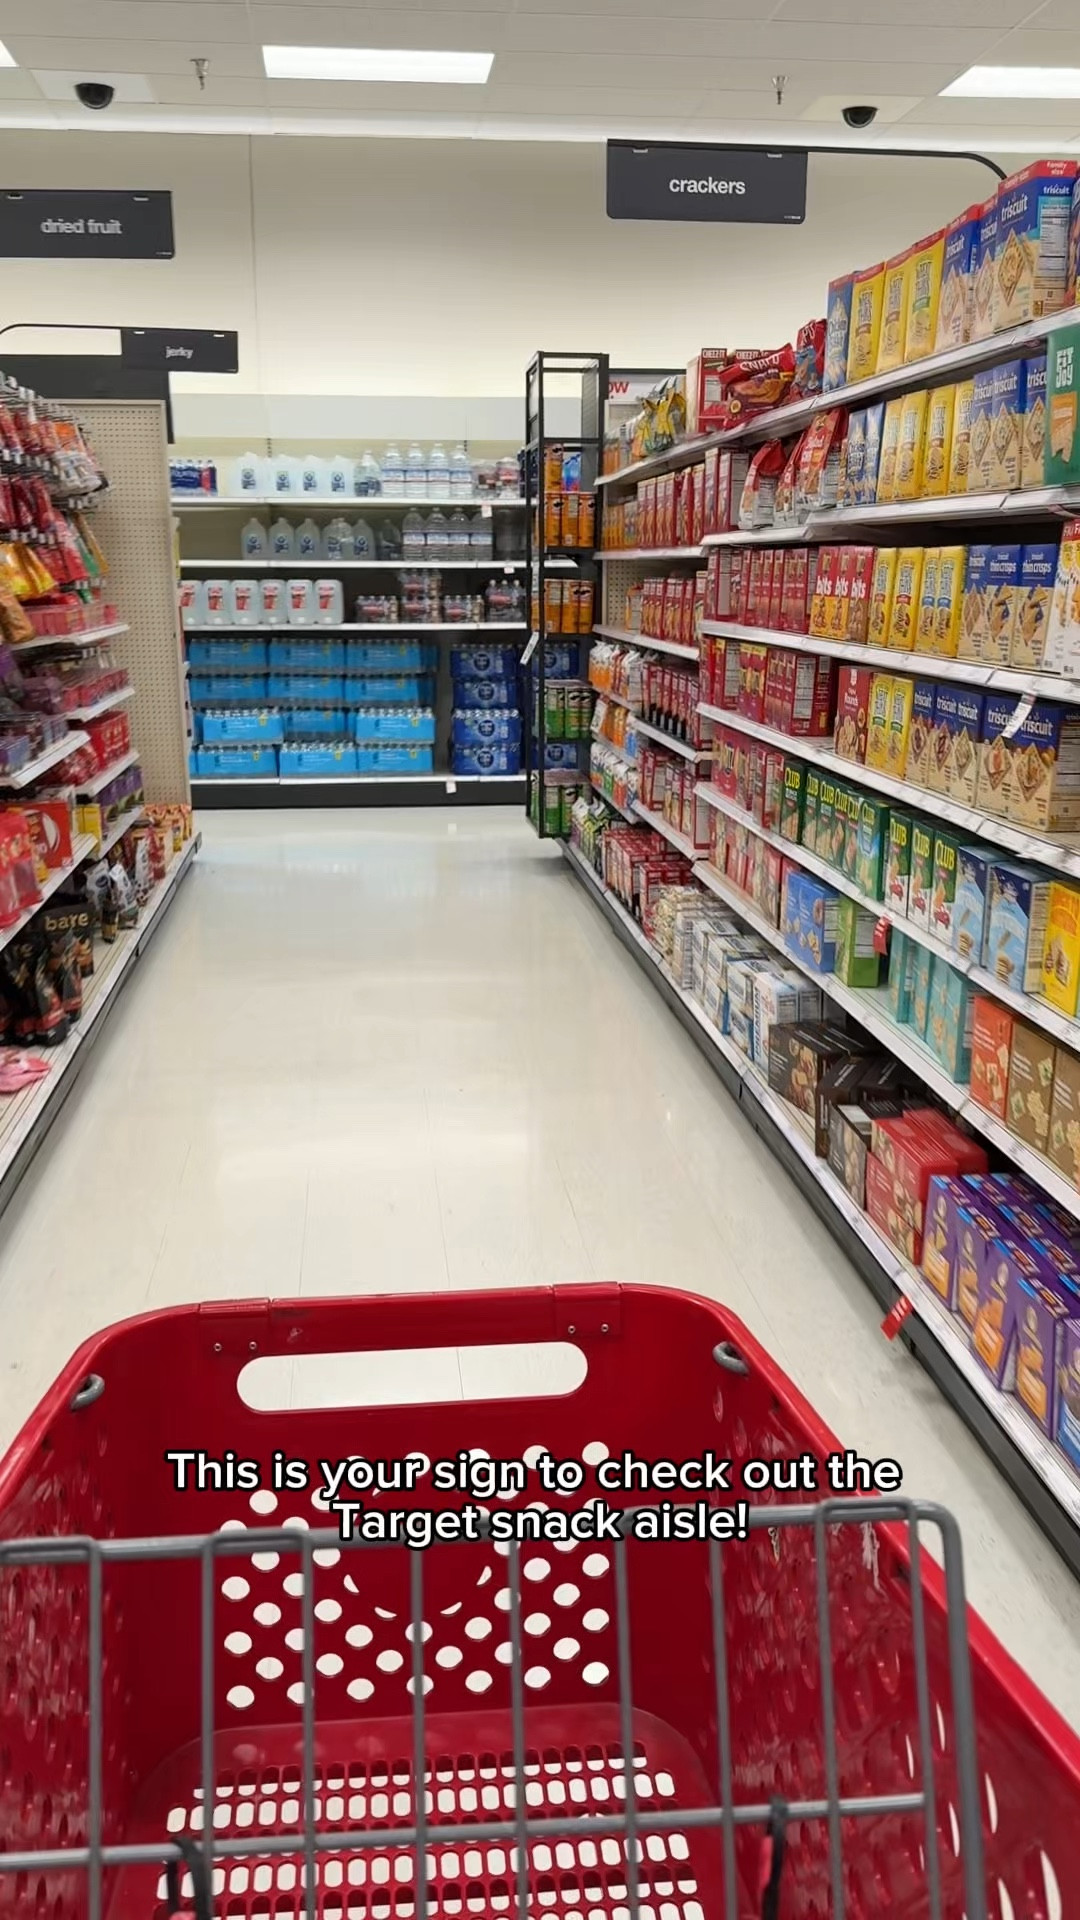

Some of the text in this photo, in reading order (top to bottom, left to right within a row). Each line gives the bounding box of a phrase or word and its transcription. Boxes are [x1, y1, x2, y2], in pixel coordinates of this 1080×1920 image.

[669, 176, 746, 195] crackers
[1043, 184, 1070, 194] triscuit
[1001, 193, 1028, 222] triscuit
[41, 218, 123, 234] dried fruit
[165, 346, 193, 359] jerky
[914, 689, 932, 708] triscuit
[936, 695, 957, 712] triscuit
[957, 697, 978, 721] triscuit
[784, 767, 801, 789] CLUB
[806, 772, 819, 796] CLUB
[820, 780, 835, 804] CLUB
[861, 802, 875, 826] CLUB
[889, 817, 907, 847] CLUB
[912, 827, 930, 858] CLUB
[934, 839, 955, 871] CLUB
[44, 912, 89, 931] bare
